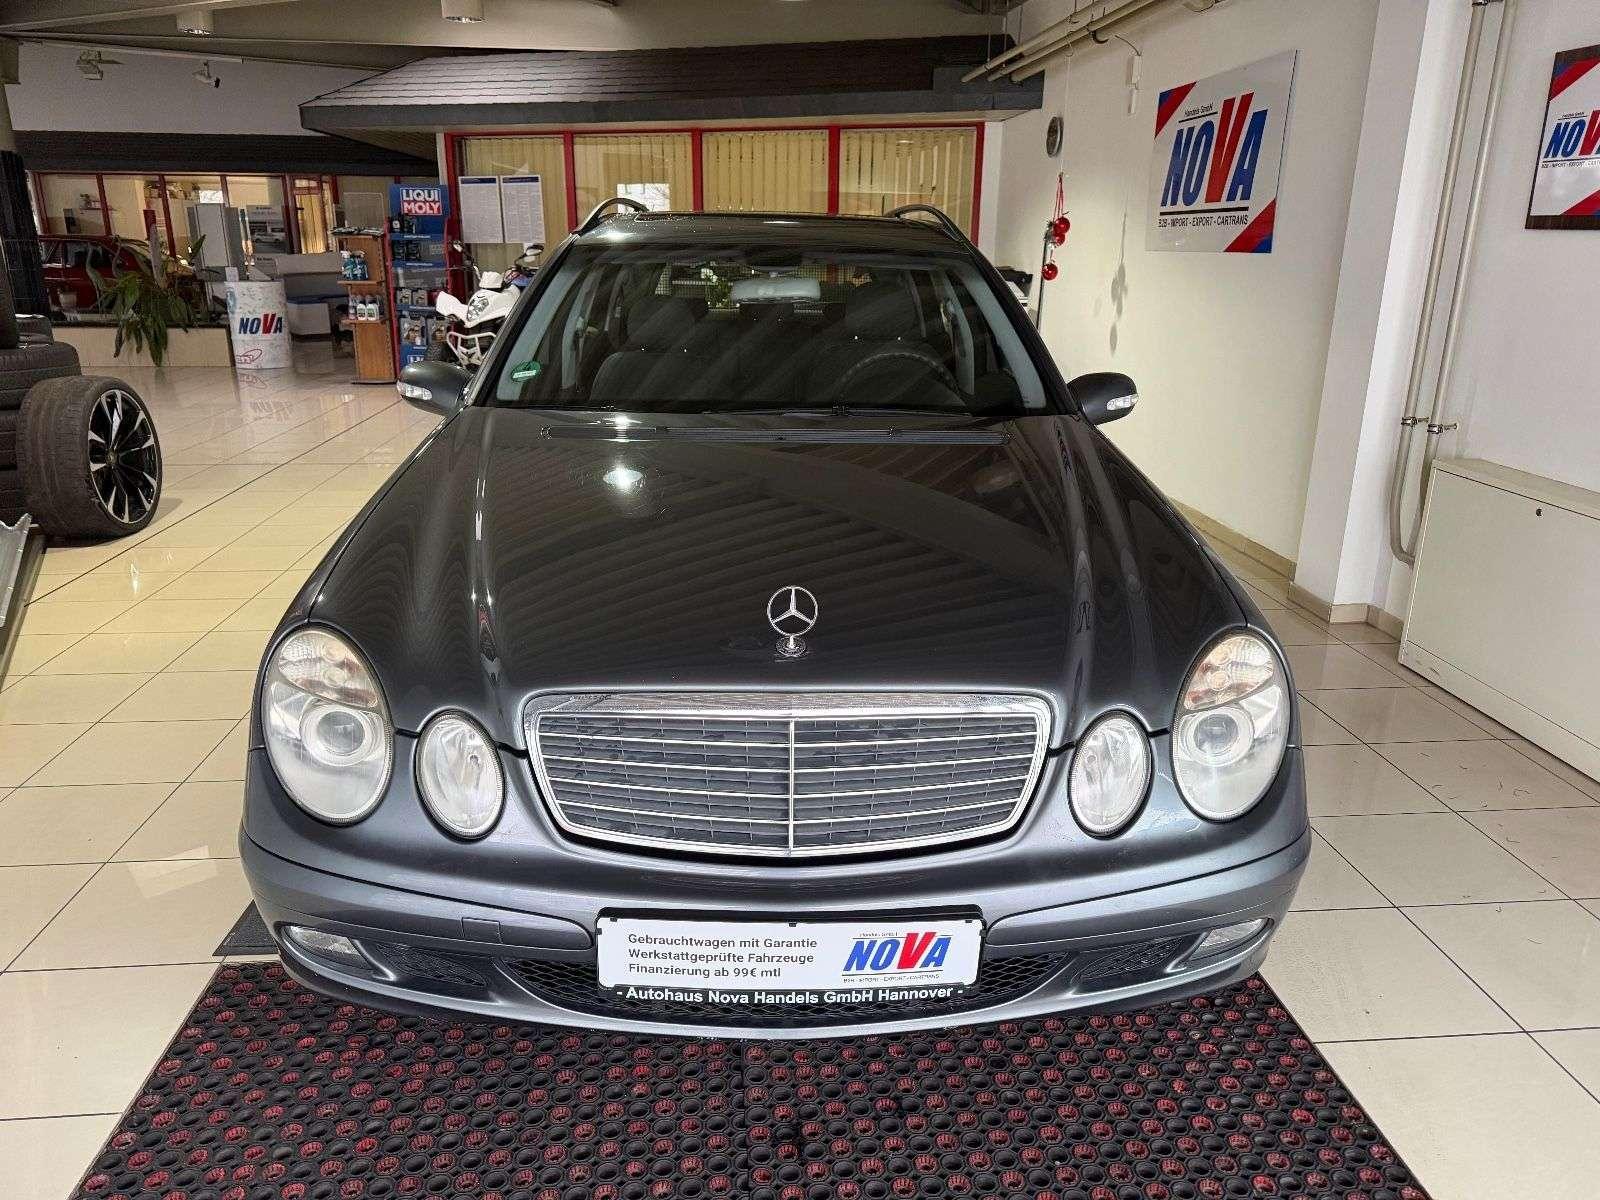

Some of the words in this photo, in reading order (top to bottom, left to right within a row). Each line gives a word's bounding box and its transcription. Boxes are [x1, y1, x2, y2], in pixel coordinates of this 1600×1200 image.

[1160, 92, 1268, 207] NOVA
[402, 188, 439, 201] LIQUI
[402, 202, 441, 215] MOLY
[1192, 216, 1213, 227] EXPORT
[1217, 214, 1249, 226] CARTRANS
[239, 313, 283, 335] NOVA
[628, 933, 735, 952] Gebrauchtwagen
[739, 938, 760, 948] mit
[763, 938, 817, 948] Garantie
[842, 931, 952, 972] NOVA
[628, 948, 744, 964] Werkstattgeprüfte
[748, 953, 814, 965] Fahrzeuge
[629, 963, 710, 979] Finanzierung
[714, 967, 729, 977] ab
[733, 967, 757, 977] 99€
[760, 967, 781, 977] mtl
[625, 986, 703, 1003] Autohaus
[708, 990, 749, 1004] Nova
[754, 991, 819, 1005] Handels
[823, 990, 874, 1004] GmbH
[878, 986, 954, 1002] Hannover
